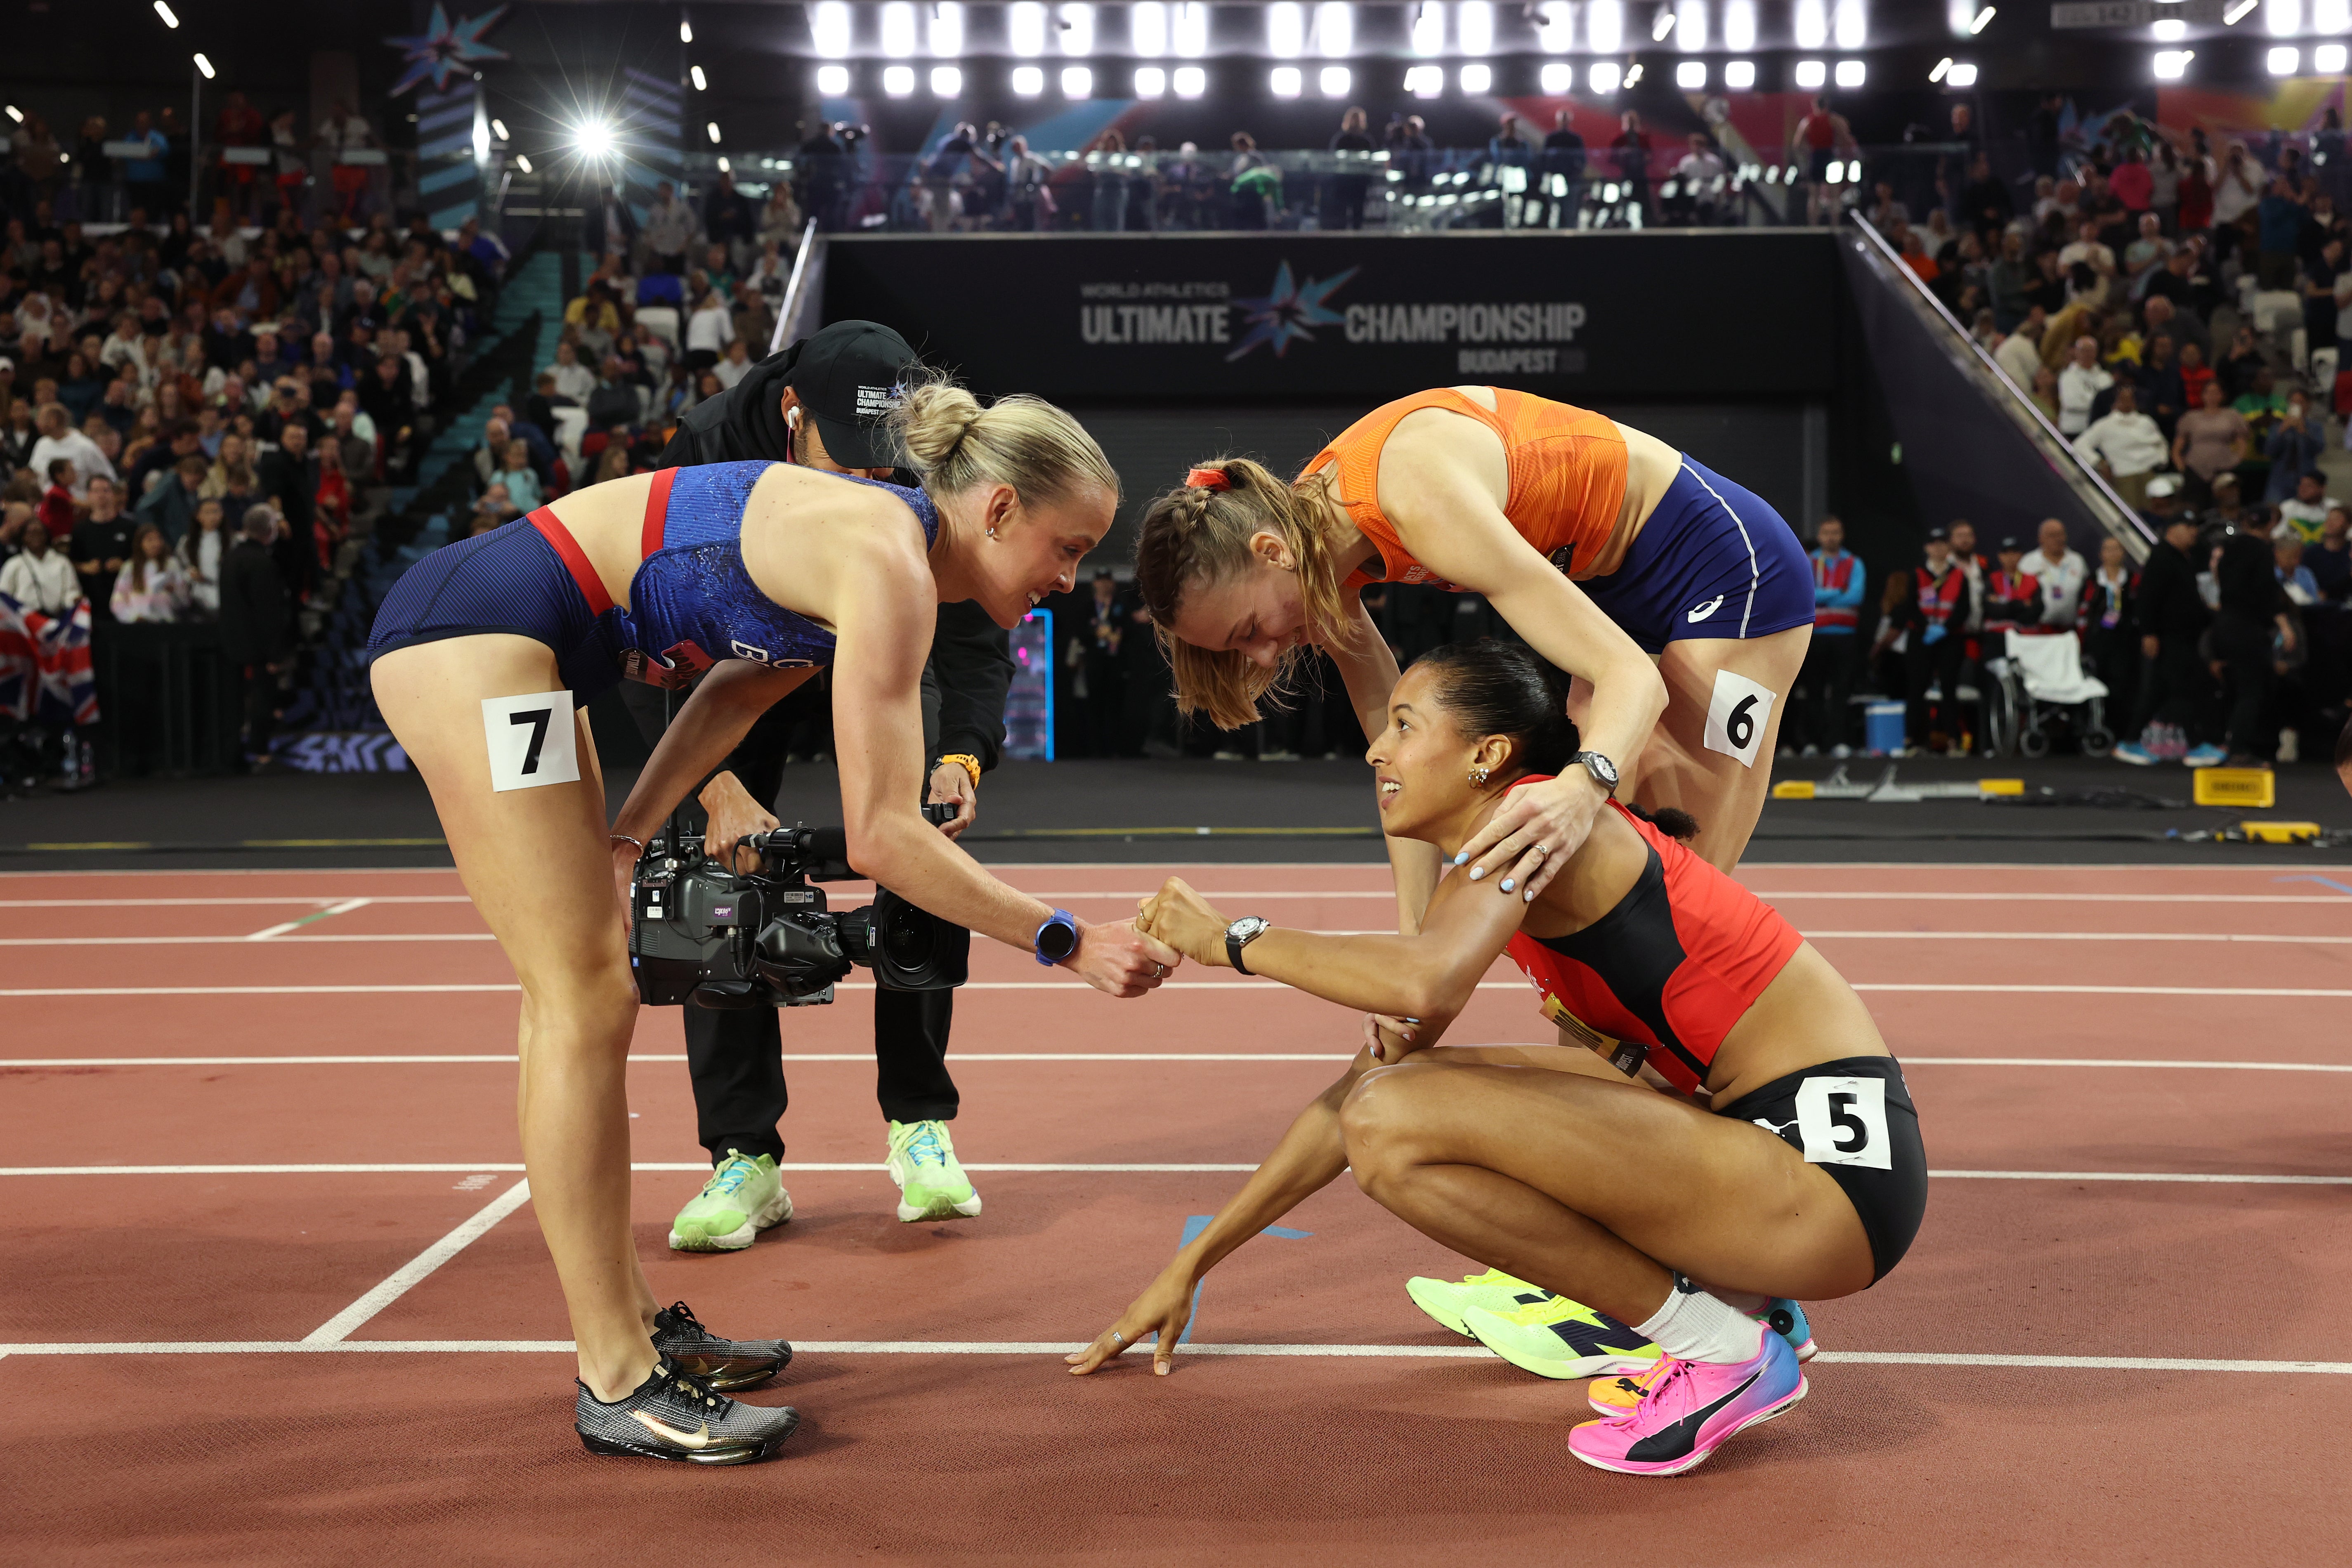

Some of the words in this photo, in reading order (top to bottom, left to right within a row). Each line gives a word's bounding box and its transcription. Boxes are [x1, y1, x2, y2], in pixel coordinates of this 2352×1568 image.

[1080, 282, 1140, 298] WORLD
[1143, 282, 1230, 298] ATHLETICS
[1081, 305, 1230, 343] ULTIMATE
[1344, 303, 1585, 342] CHAMPIONSHIP
[1457, 349, 1556, 373] BUDAPEST
[857, 390, 886, 399] ULTIMATE
[857, 398, 901, 409] CHAMPIONSHIP
[1726, 694, 1759, 749] 6
[509, 708, 552, 775] 7
[1828, 1093, 1869, 1153] 5
